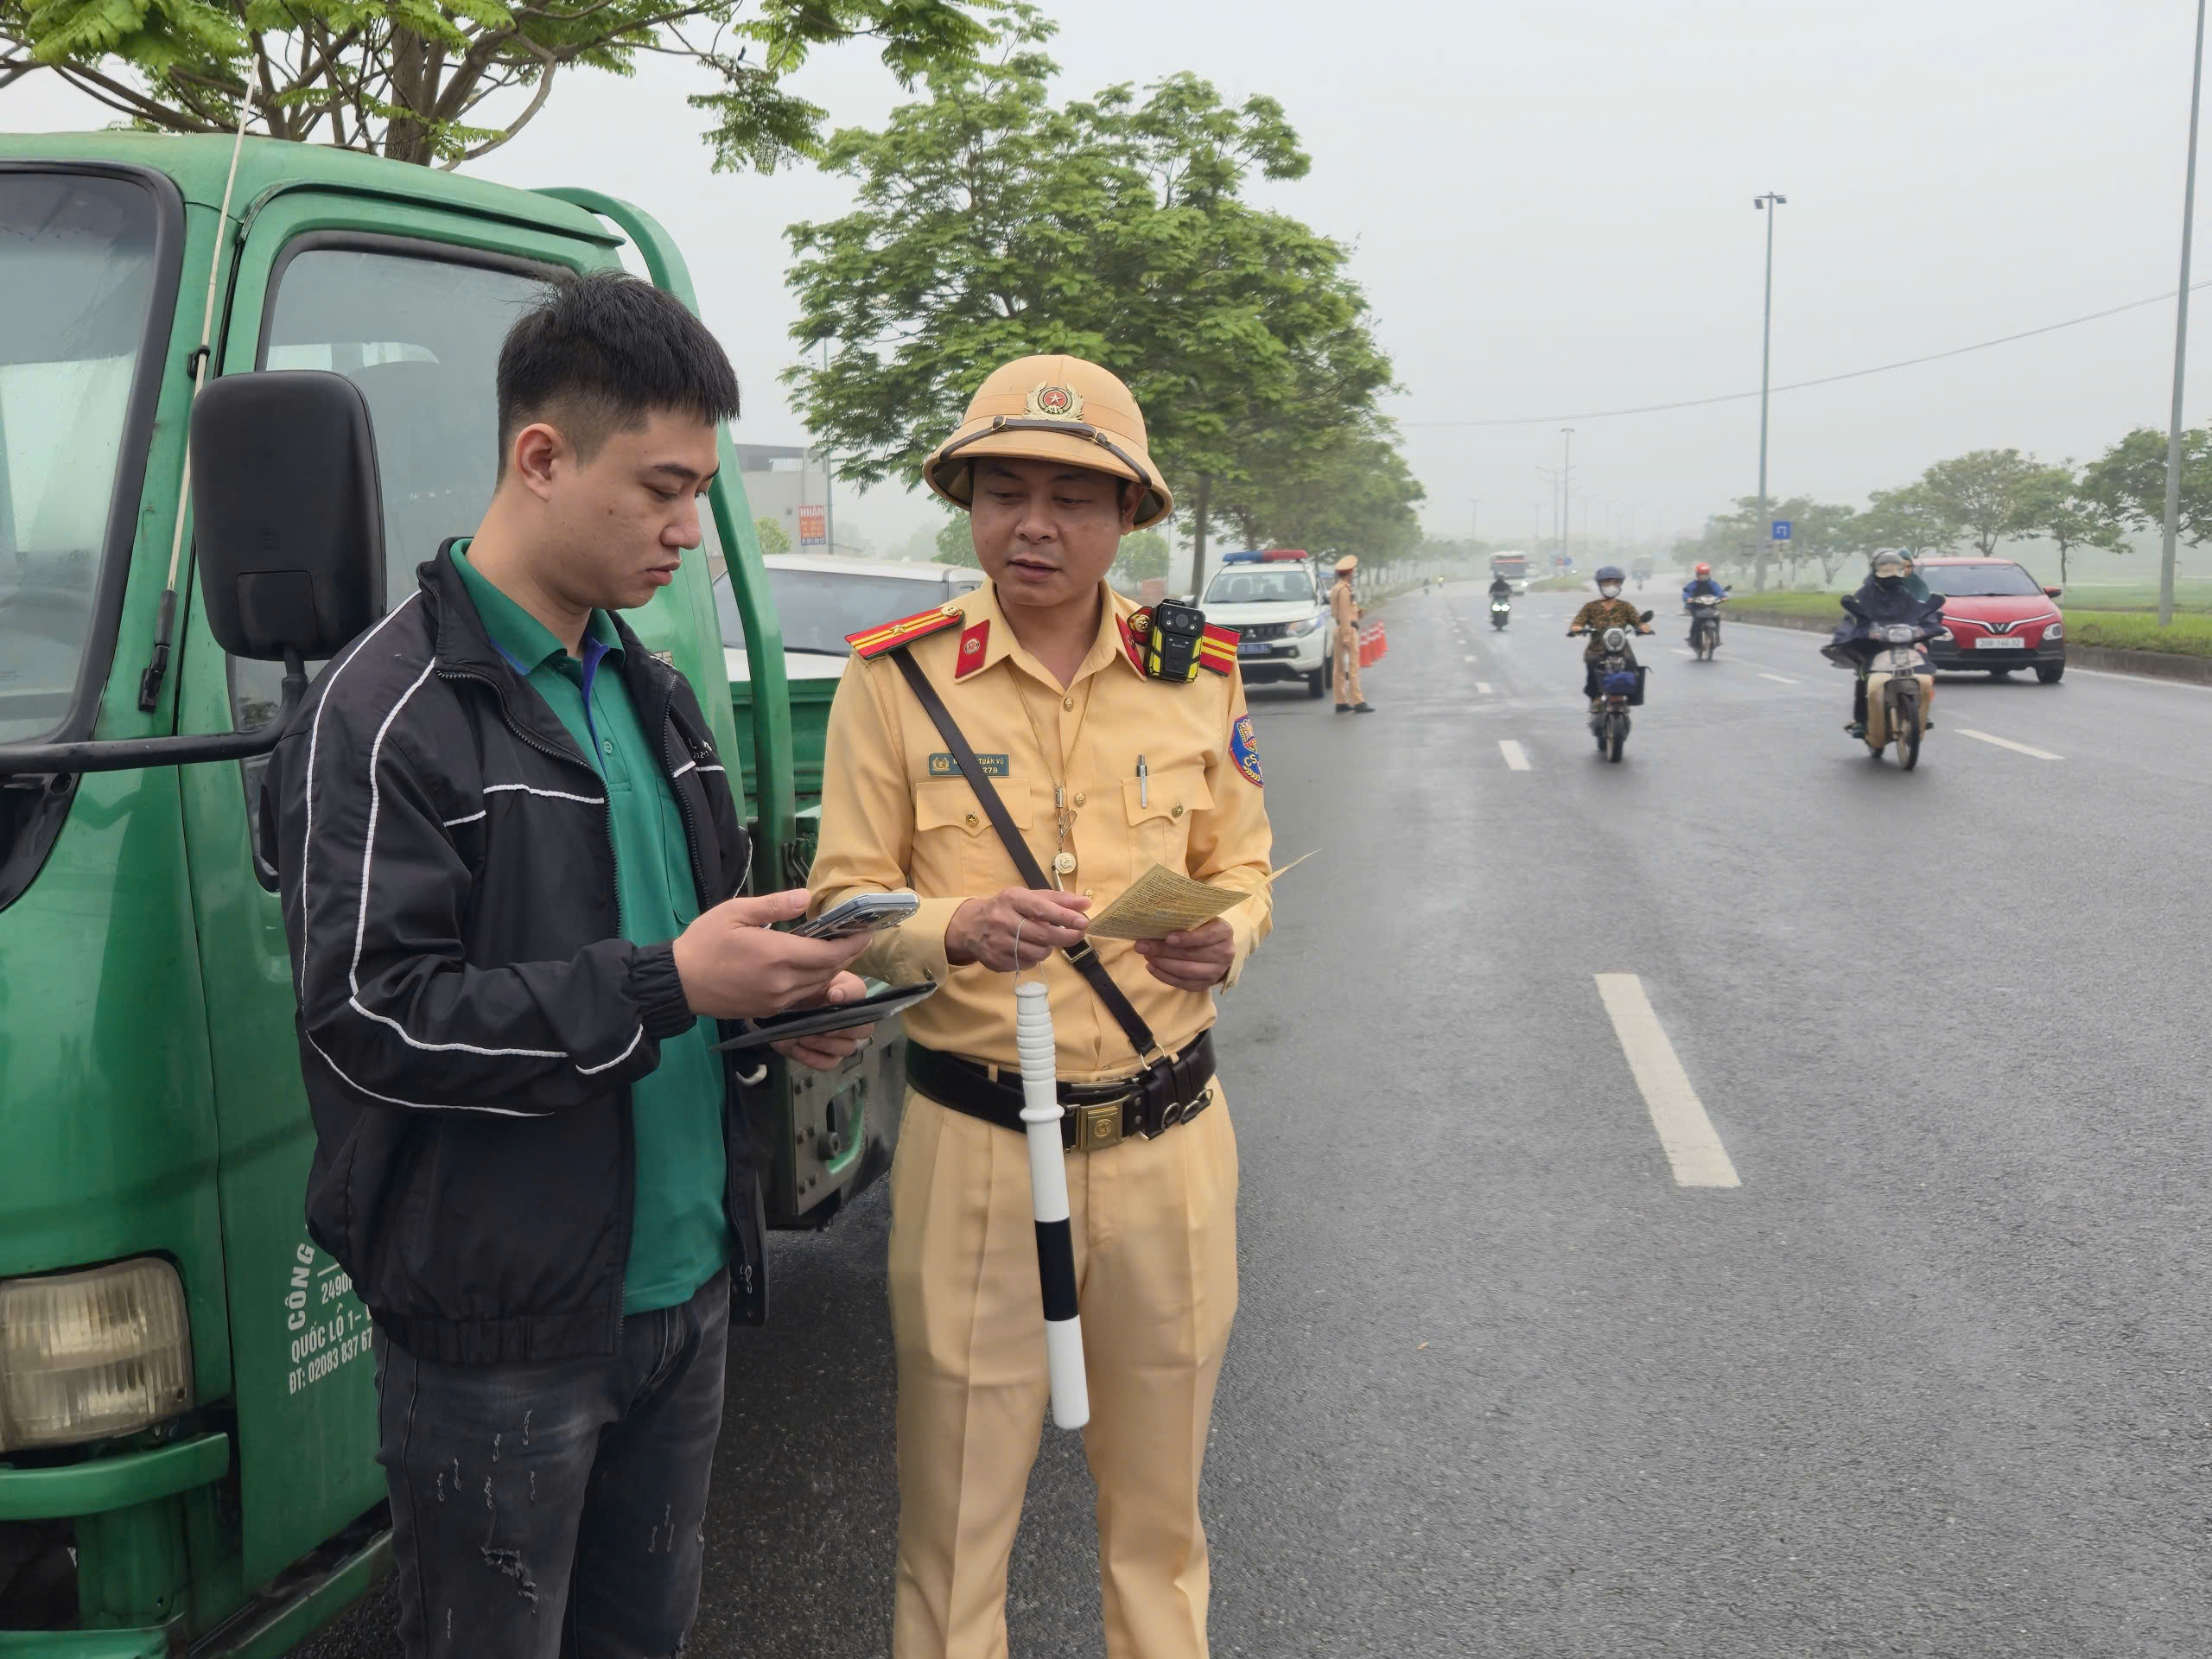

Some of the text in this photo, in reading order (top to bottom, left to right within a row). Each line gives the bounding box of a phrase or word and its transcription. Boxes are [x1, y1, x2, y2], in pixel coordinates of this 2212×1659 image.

[285, 1243, 315, 1331] CÔNG
[291, 1321, 326, 1363] QUỐC
[329, 1302, 344, 1344] LỘ
[308, 1348, 339, 1382] 02083
[341, 1335, 359, 1363] 837
